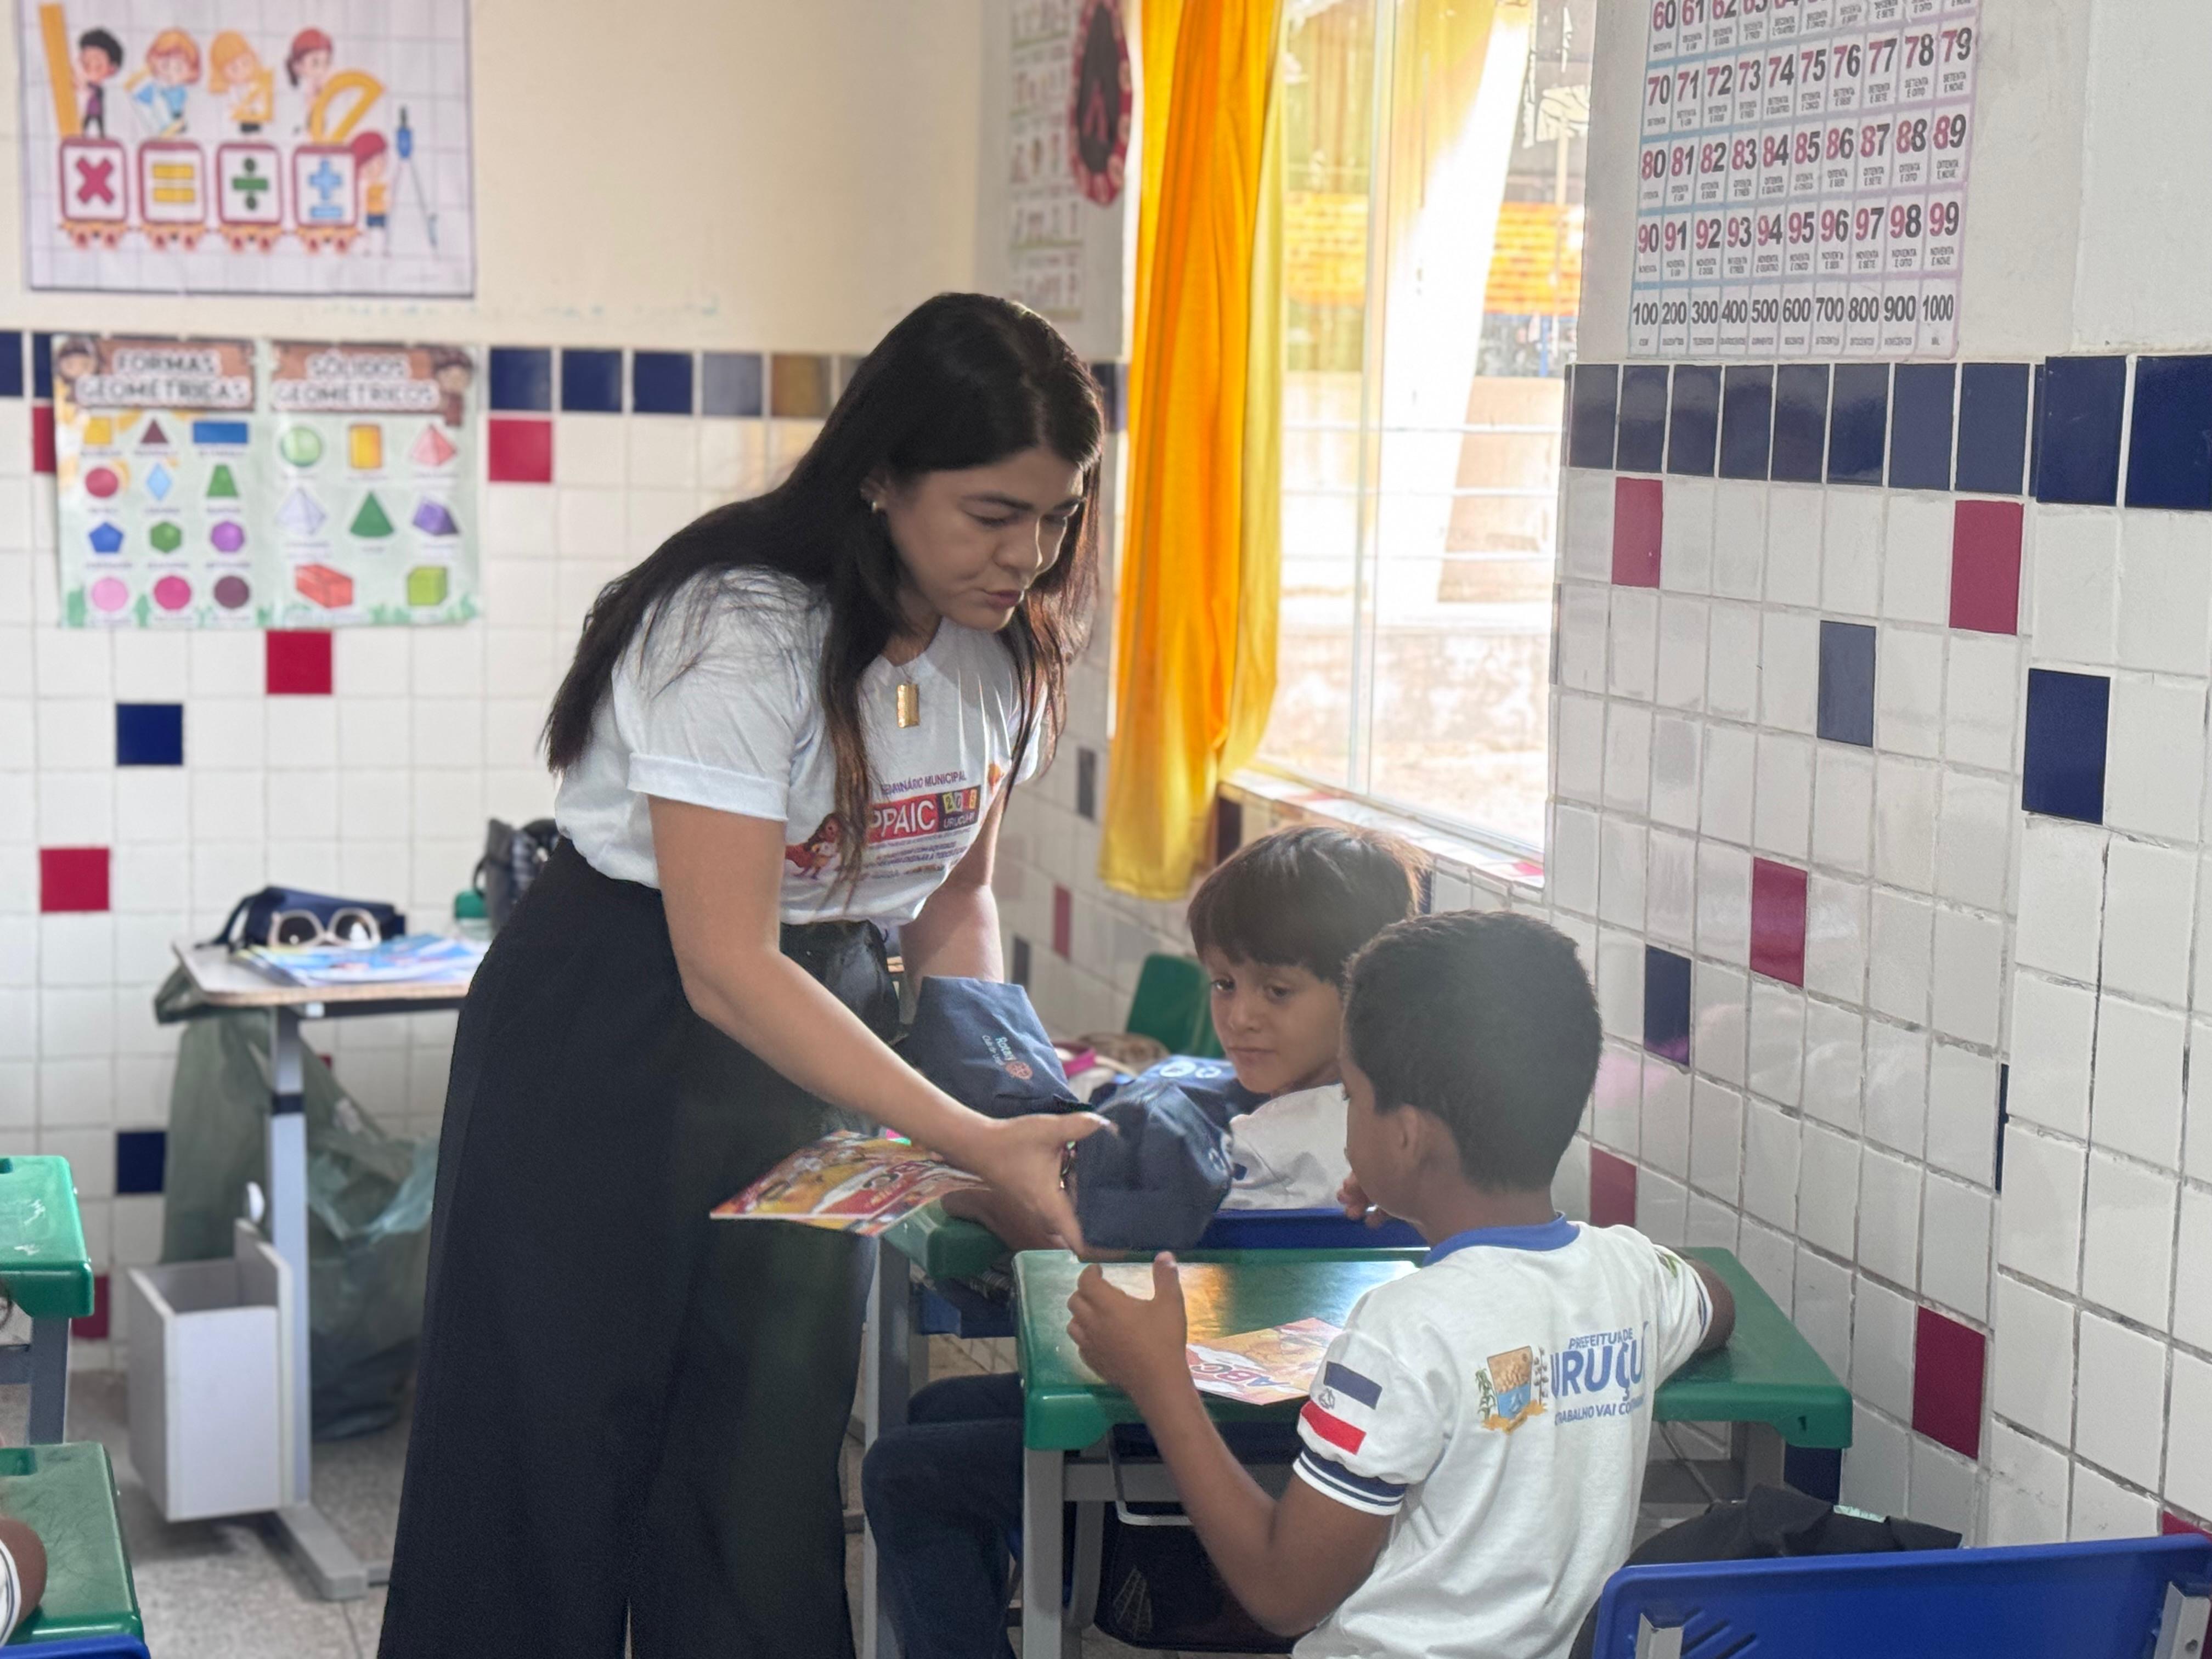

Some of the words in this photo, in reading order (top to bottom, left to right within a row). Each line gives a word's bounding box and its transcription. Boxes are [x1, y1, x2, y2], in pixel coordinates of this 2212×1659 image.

[1653, 0, 1676, 32] 60
[1682, 0, 1703, 26] 61
[1648, 75, 1671, 106] 70
[1678, 69, 1699, 101] 71
[1707, 65, 1733, 98] 72
[1739, 60, 1761, 92] 73
[1769, 54, 1794, 88] 74
[1801, 49, 1826, 83] 75
[1833, 44, 1861, 79] 76
[1869, 38, 1898, 74] 77
[1905, 33, 1934, 69] 78
[1941, 27, 1972, 62] 79
[1641, 149, 1666, 180] 80
[1671, 145, 1694, 177] 81
[1701, 142, 1726, 173] 82
[1732, 138, 1757, 170] 83
[1763, 134, 1788, 168] 84
[1795, 131, 1820, 165] 85
[1826, 127, 1854, 160] 86
[1860, 123, 1891, 158] 87
[1896, 119, 1927, 154] 88
[1933, 114, 1966, 150] 89
[1638, 223, 1659, 253] 90
[1664, 221, 1686, 251] 91
[1696, 218, 1722, 250] 92
[1727, 217, 1752, 247] 93
[1757, 213, 1782, 246] 94
[1788, 211, 1814, 244] 95
[1821, 208, 1849, 242] 96
[1855, 207, 1884, 241] 97
[1890, 204, 1922, 239] 98
[1929, 201, 1960, 236] 99
[1633, 302, 1658, 325] 100
[1661, 301, 1687, 325] 200
[1691, 300, 1718, 324] 300
[1722, 299, 1748, 324] 400
[1751, 298, 1779, 324] 500
[1783, 297, 1811, 323] 600
[1815, 297, 1844, 323] 700
[1848, 296, 1879, 323] 800
[1884, 295, 1916, 322] 900
[1922, 294, 1954, 321] 1000
[117, 354, 215, 374] FORMAS
[924, 771, 966, 786] MUNICIPAL
[995, 1036, 1017, 1061] Rotary
[1555, 1405, 1594, 1426] RABALHO
[1595, 1403, 1617, 1417] VAI
